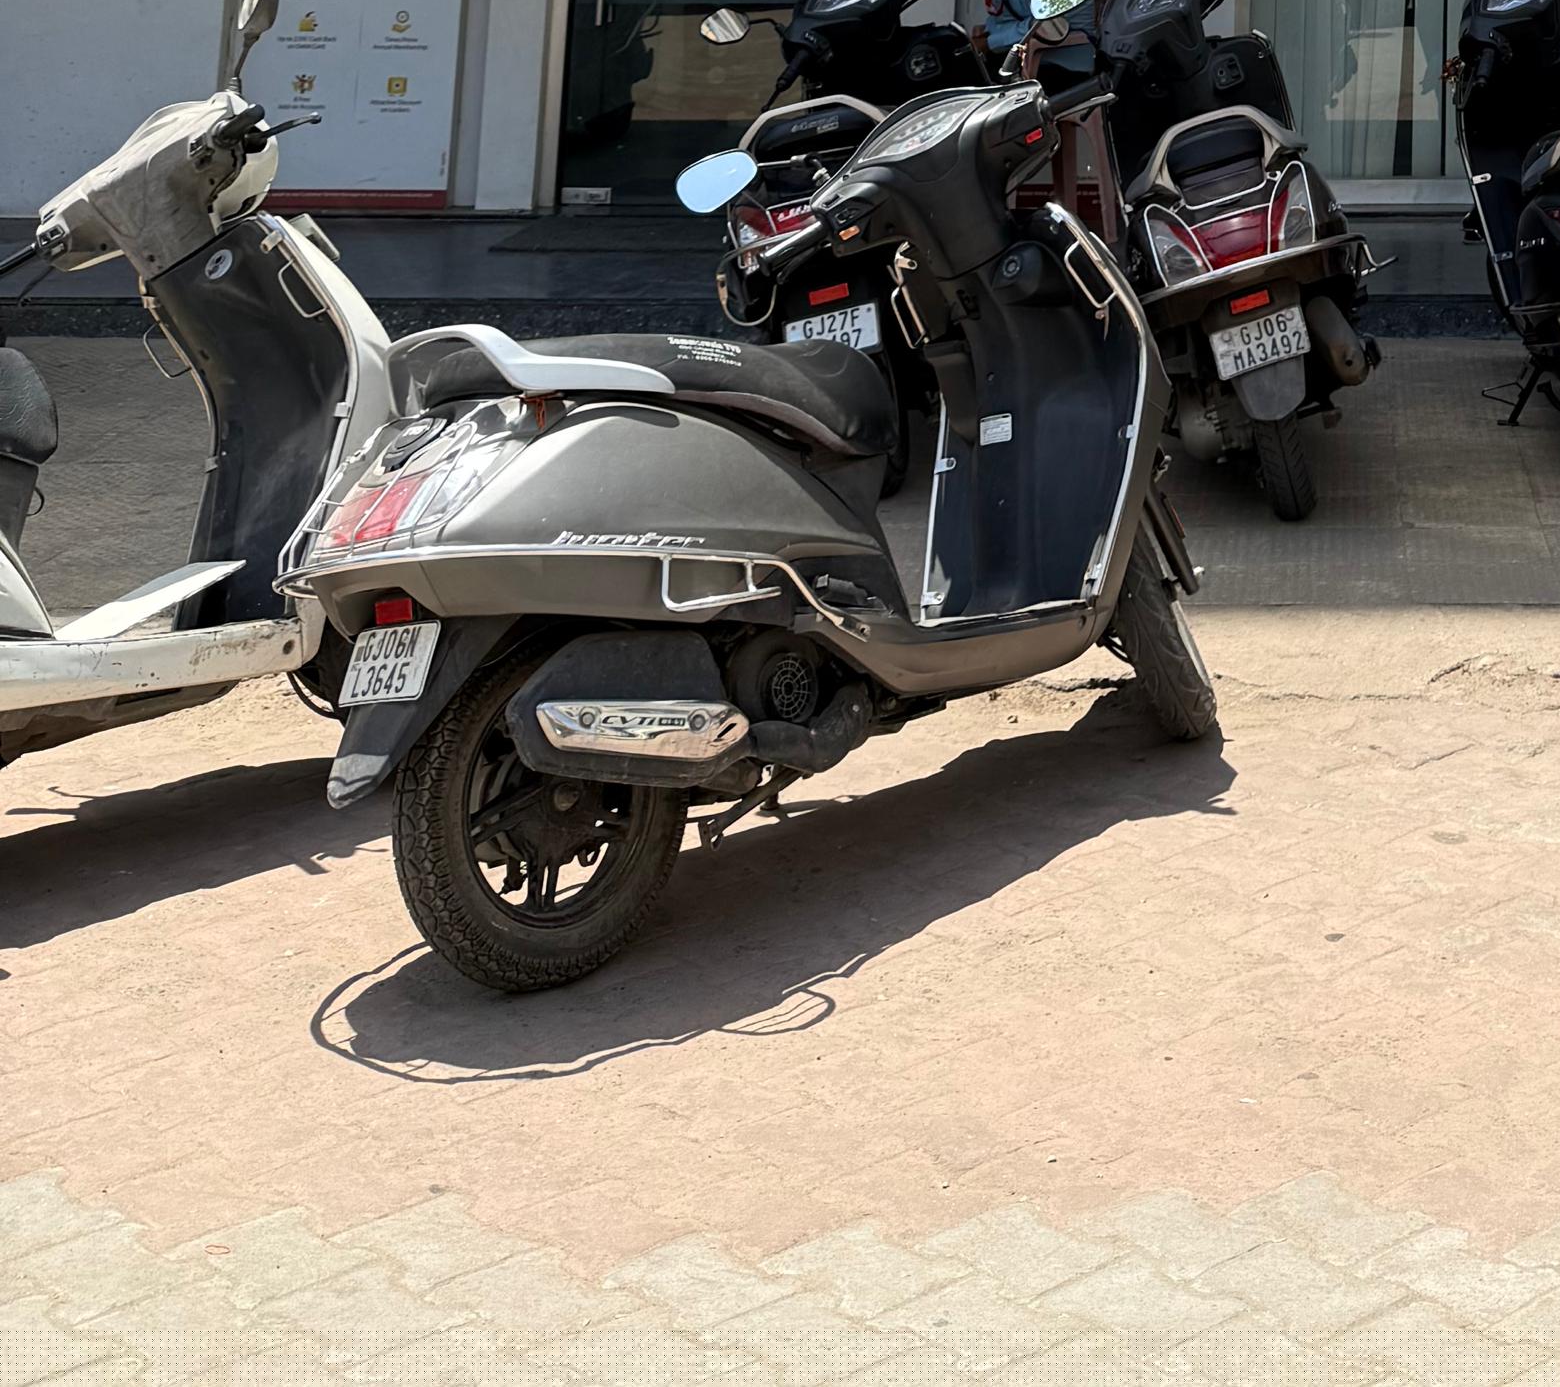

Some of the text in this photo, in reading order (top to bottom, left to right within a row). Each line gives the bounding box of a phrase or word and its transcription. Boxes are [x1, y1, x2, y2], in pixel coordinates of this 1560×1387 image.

[803, 307, 860, 339] GJ27F
[1240, 314, 1288, 345] GJ06
[1233, 331, 1305, 371] MA3492
[363, 626, 422, 663] GJ06N
[350, 662, 410, 698] L3645
